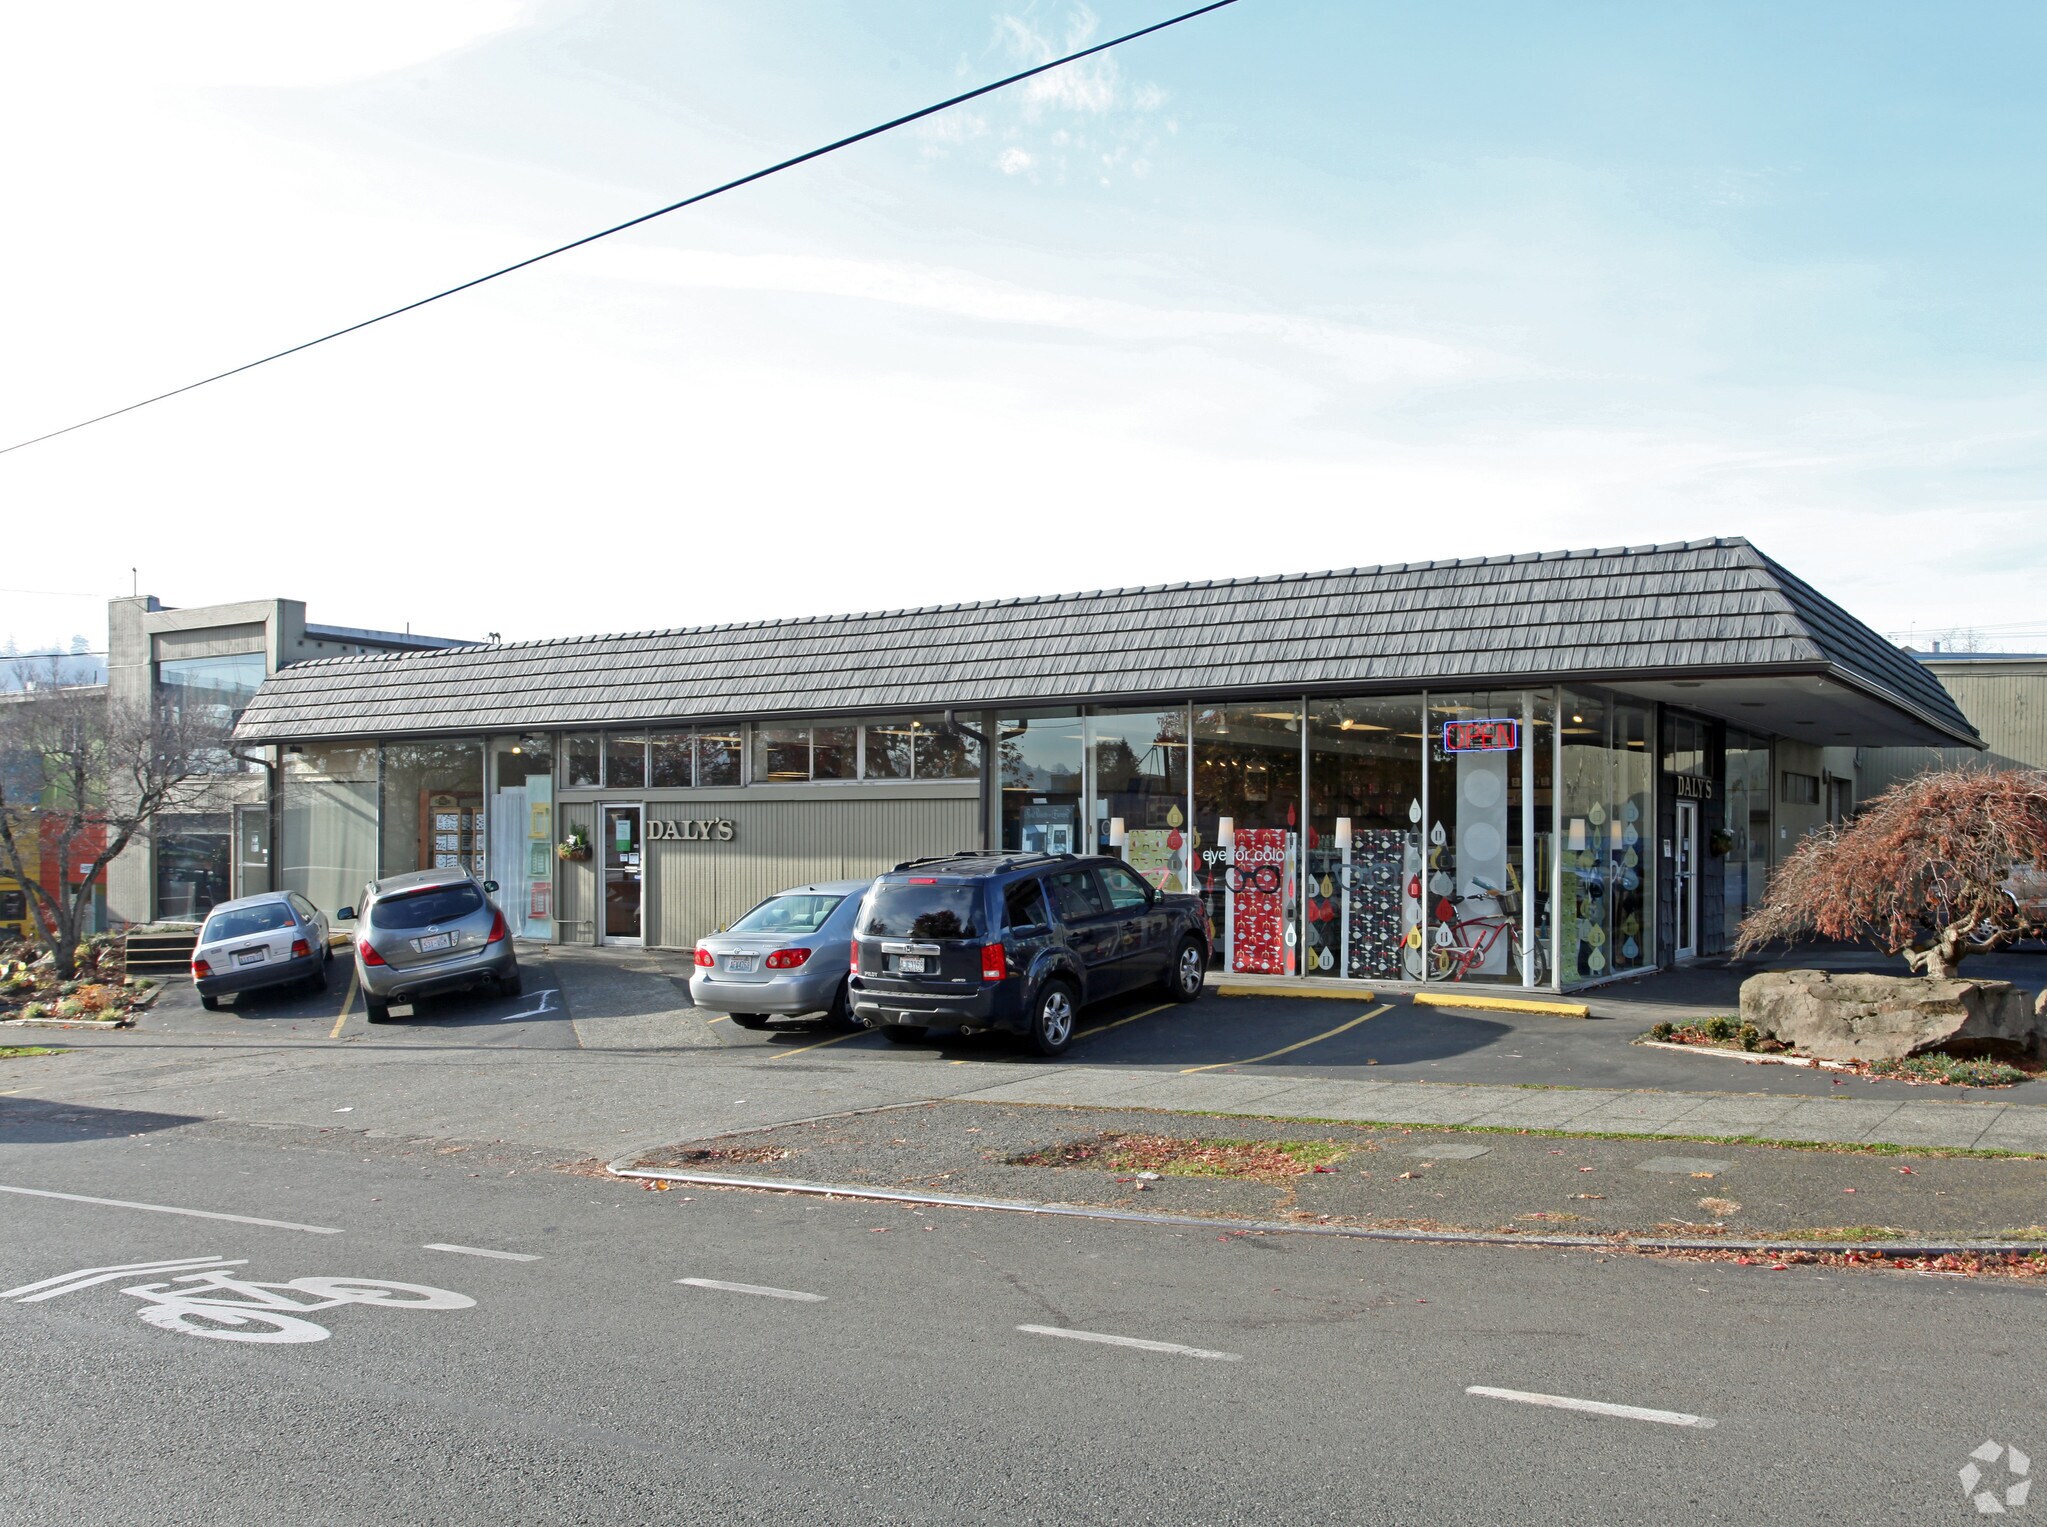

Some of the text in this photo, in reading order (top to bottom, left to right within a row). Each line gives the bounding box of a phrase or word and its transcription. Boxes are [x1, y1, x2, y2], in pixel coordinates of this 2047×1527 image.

[1447, 724, 1515, 749] OPEN
[1677, 775, 1712, 799] DALY'S
[646, 817, 733, 841] DALY'S
[1202, 850, 1227, 865] eye
